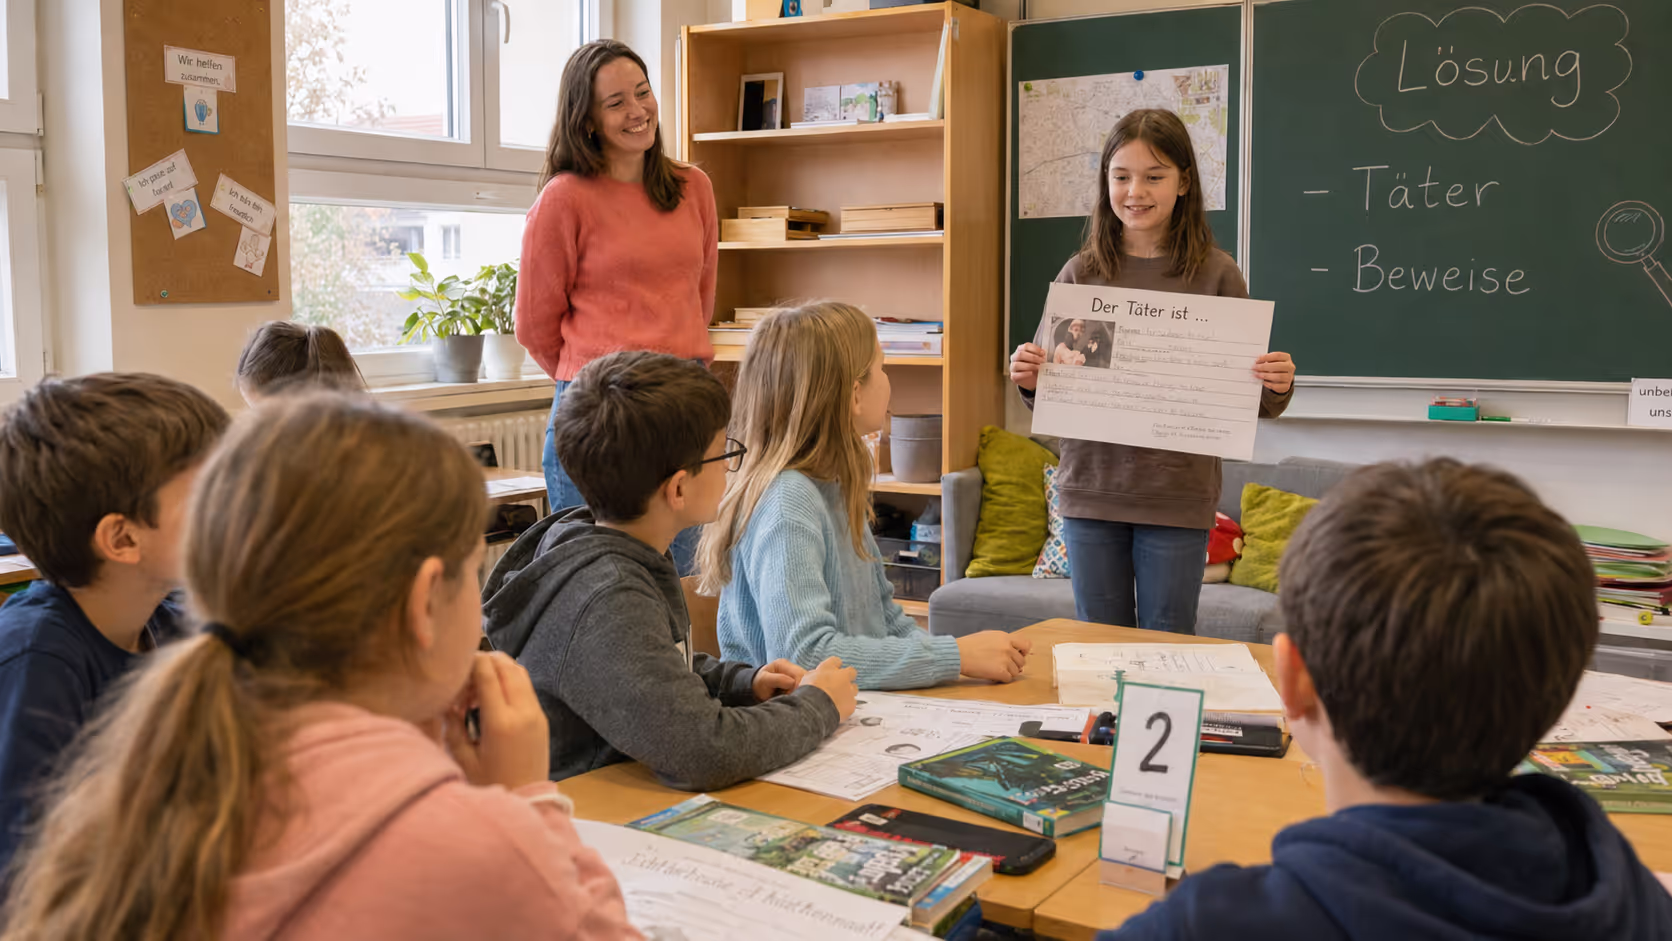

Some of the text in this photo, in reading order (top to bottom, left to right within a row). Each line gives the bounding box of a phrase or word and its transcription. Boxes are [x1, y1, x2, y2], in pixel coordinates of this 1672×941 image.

[178, 54, 222, 70] Wir helfen
[1397, 39, 1581, 108] Lösung
[1352, 164, 1500, 211] Täter
[1352, 243, 1531, 295] Beweise
[1091, 297, 1119, 314] Der
[1127, 300, 1165, 318] Täter
[1170, 306, 1189, 320] ist
[1139, 711, 1172, 774] 2
